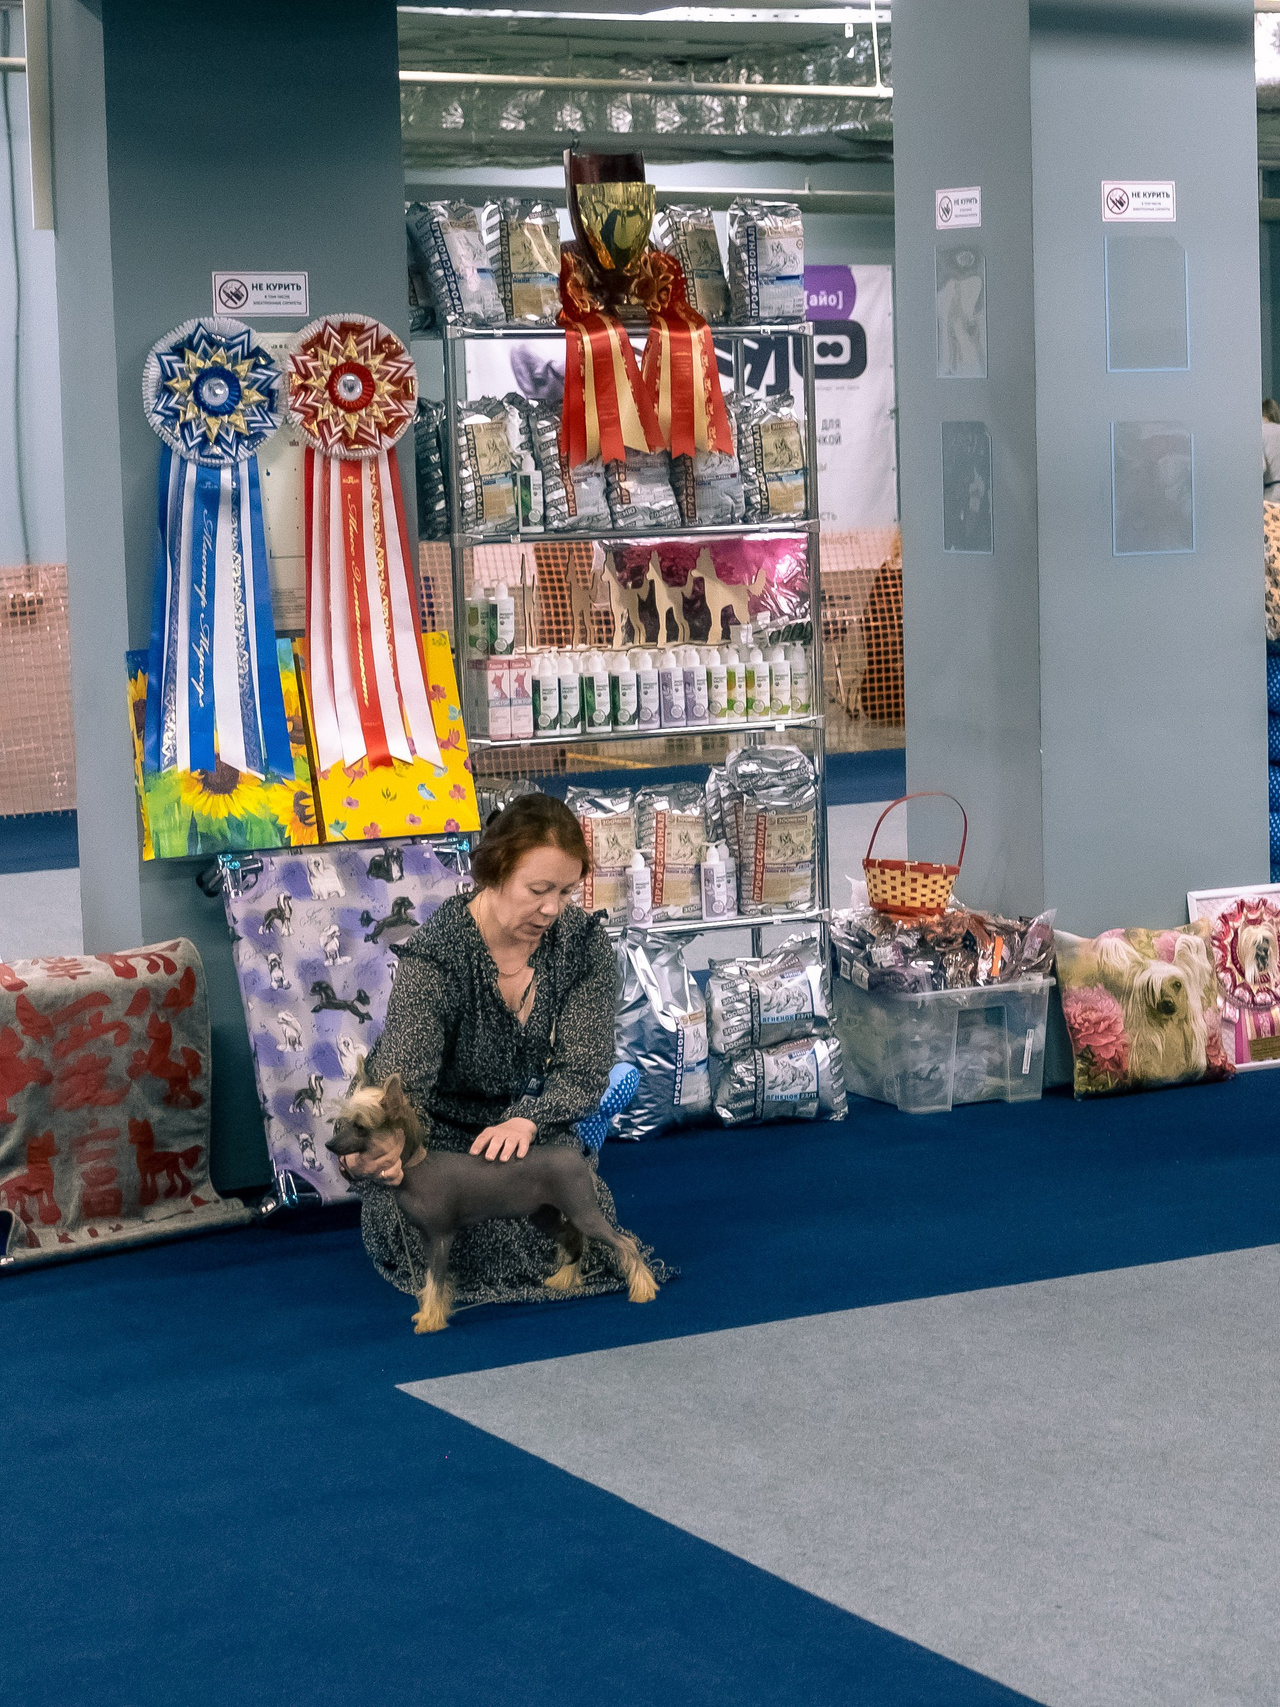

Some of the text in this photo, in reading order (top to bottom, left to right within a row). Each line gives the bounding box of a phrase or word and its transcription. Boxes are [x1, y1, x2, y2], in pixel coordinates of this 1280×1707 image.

[1131, 191, 1171, 199] НЕ КУРИТЬ
[251, 282, 302, 291] НЕ КУРИТЬ
[430, 221, 464, 314] ПРОФЕССИОНАЛ
[500, 221, 513, 315] ПРОФЕССИОНАЛ
[746, 225, 760, 318] ПРОФЕССИОНАЛ
[751, 424, 769, 514] ПРОФЕССИОНАЛ
[821, 418, 841, 431] ДЛЯ
[465, 425, 485, 519] ПРОФЕССИОНАЛ
[654, 813, 666, 903] ПРОФЕССИОНАЛ
[753, 816, 766, 901] ПРОФЕССИОНАЛ
